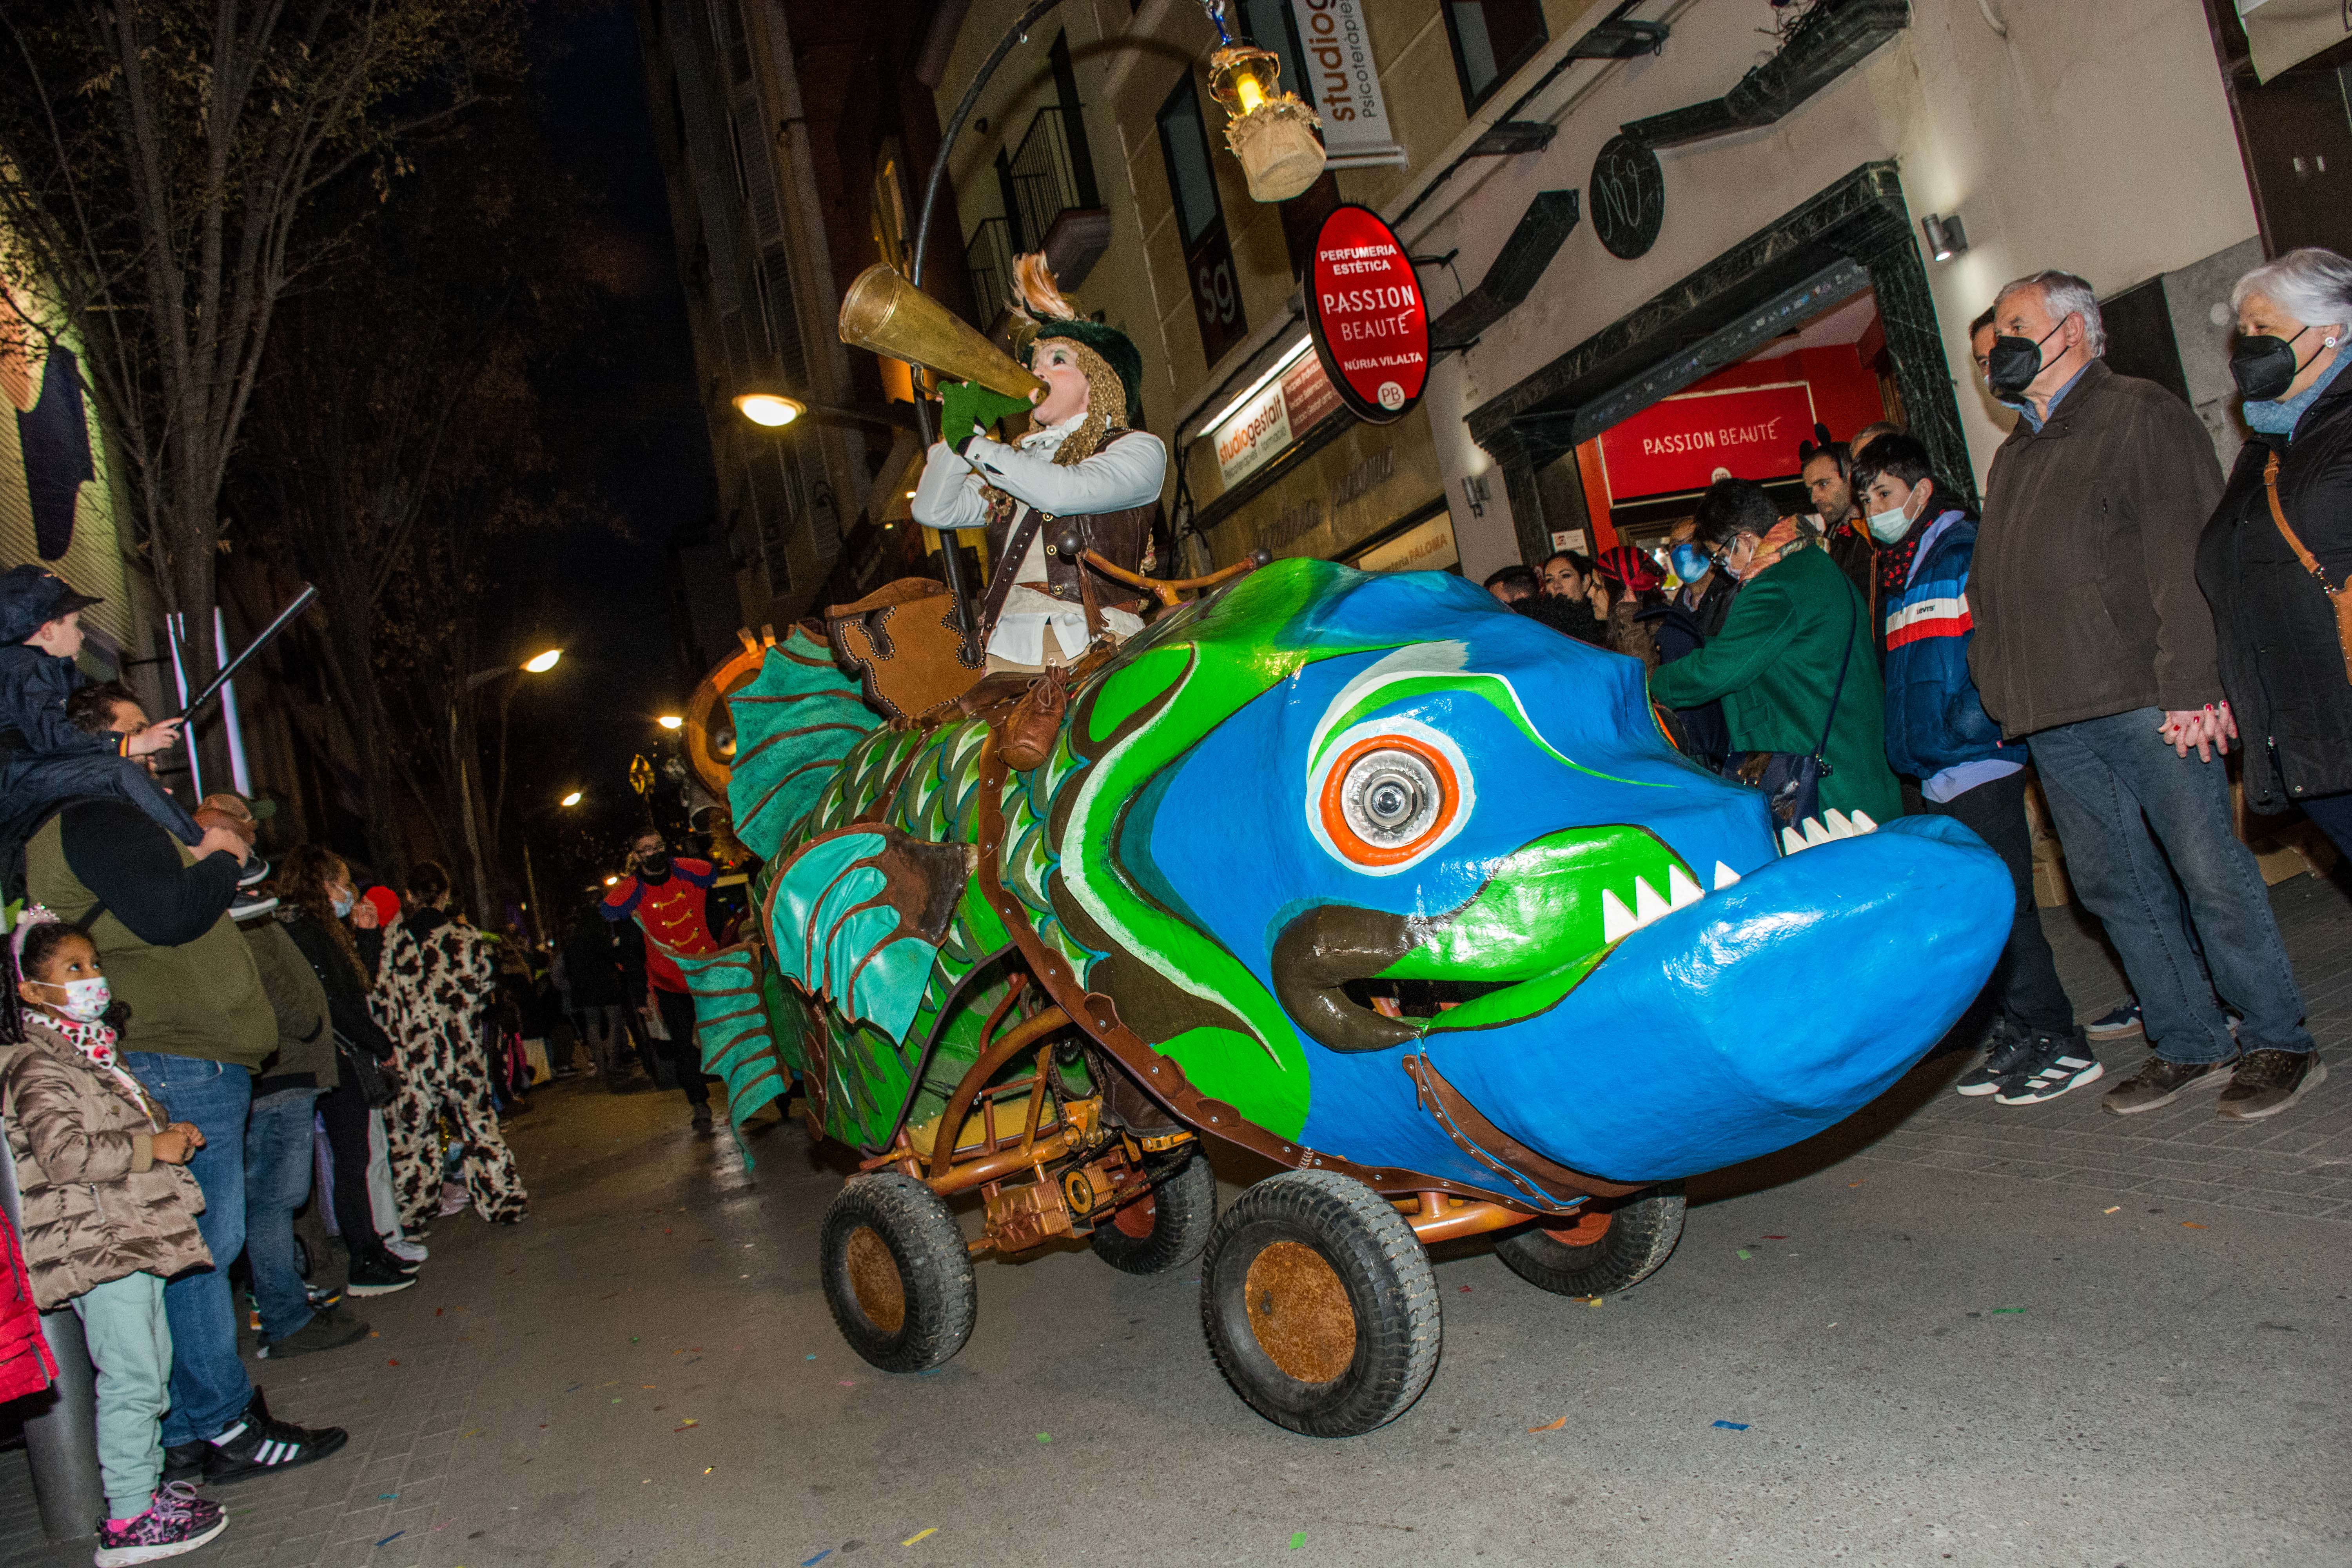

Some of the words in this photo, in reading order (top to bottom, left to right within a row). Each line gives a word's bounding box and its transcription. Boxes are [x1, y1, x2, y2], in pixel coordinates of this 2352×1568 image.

[1340, 0, 1376, 118] Psicoteràpie
[1320, 245, 1397, 261] PERFUMERIA
[1323, 285, 1415, 314] PASSION
[1342, 309, 1415, 341] BEAUTÉ
[1344, 355, 1379, 371] NÚRIA
[1379, 352, 1423, 368] VILALTA
[1382, 387, 1401, 402] PB
[1219, 394, 1283, 465] studiogestalt
[1643, 431, 1715, 456] PASSION
[1719, 416, 1781, 446] BEAUTÉ
[1408, 534, 1448, 562] PALOMA
